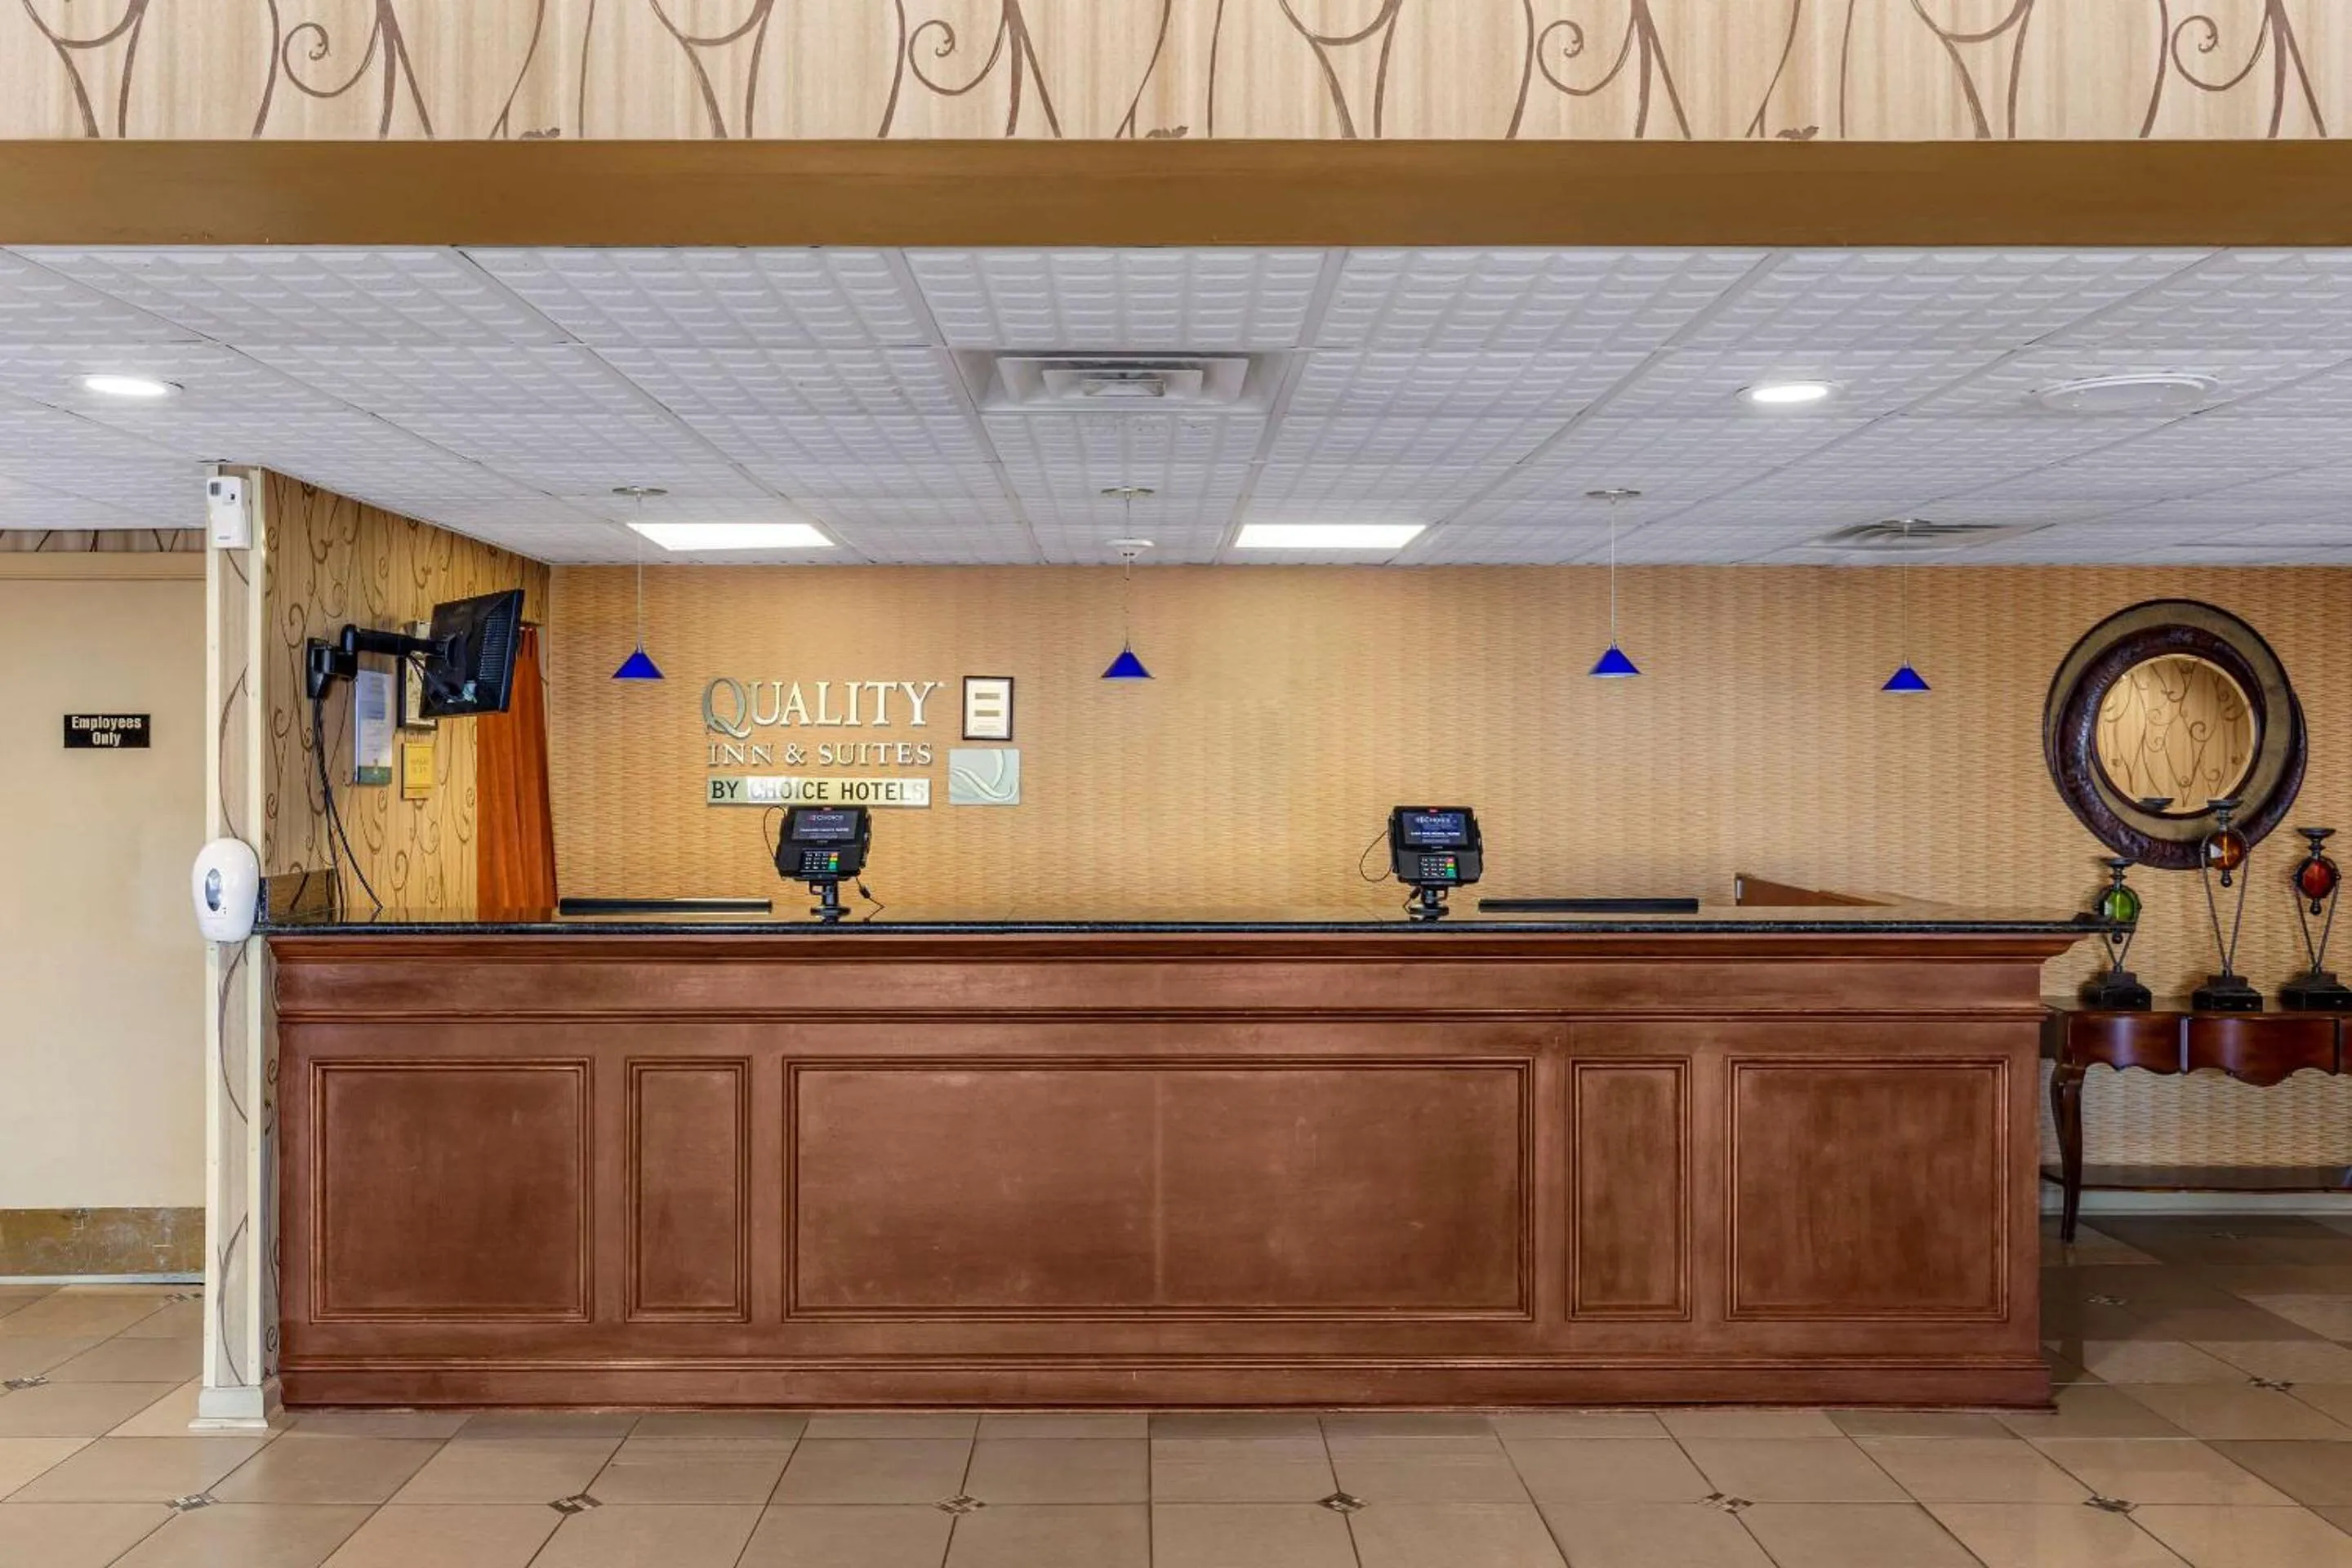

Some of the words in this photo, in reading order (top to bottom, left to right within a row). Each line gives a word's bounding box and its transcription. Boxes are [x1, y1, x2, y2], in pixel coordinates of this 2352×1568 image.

[702, 677, 936, 738] QUALITY
[71, 715, 142, 731] Employees
[91, 731, 122, 746] Only
[707, 742, 773, 766] INN
[784, 742, 807, 766] &
[817, 742, 933, 766] SUITES
[711, 781, 739, 800] BY
[750, 782, 829, 800] CHOICE
[840, 782, 925, 802] HOTELS
